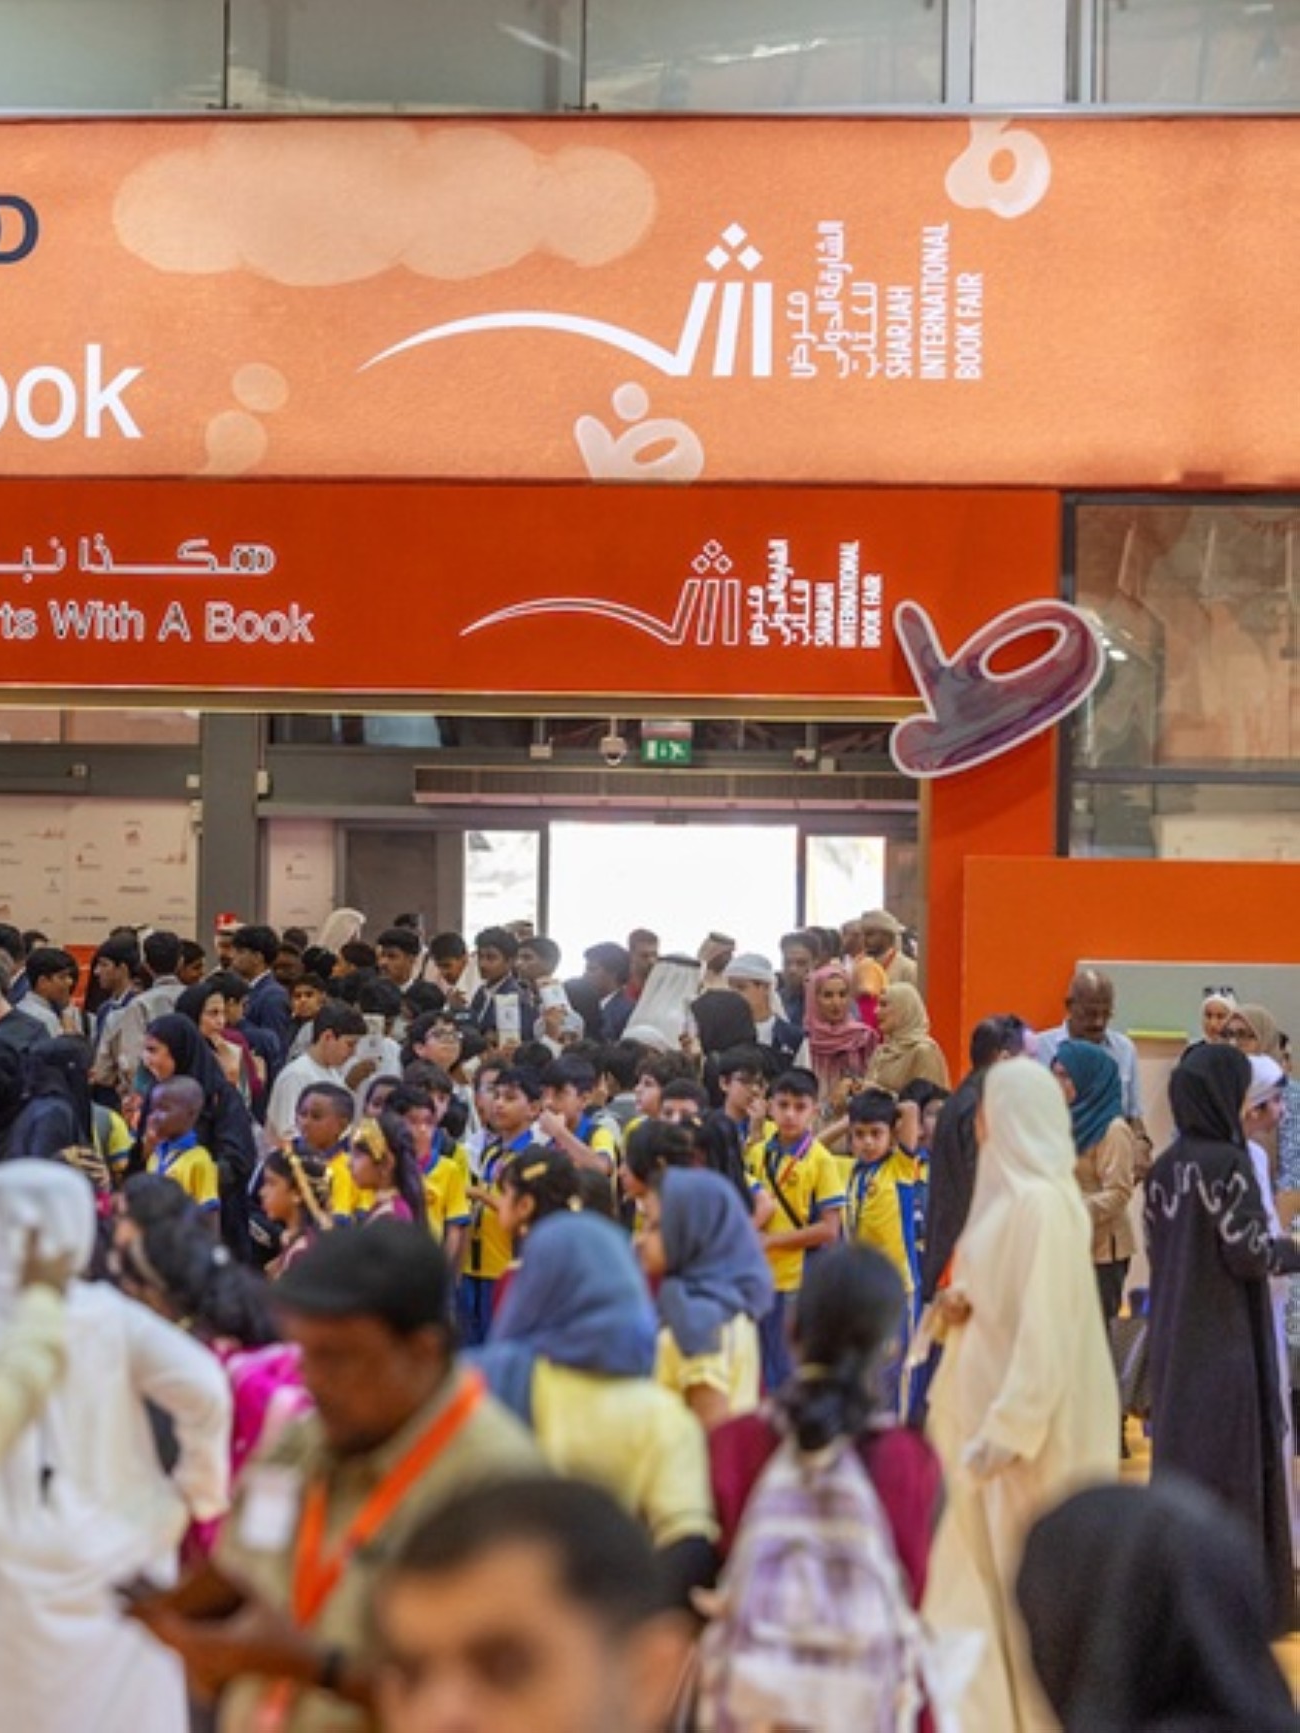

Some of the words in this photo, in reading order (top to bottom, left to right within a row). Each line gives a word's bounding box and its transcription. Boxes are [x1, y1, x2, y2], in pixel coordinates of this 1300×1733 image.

[919, 221, 950, 380] INTERNATIONAL
[954, 272, 984, 319] FAIR
[885, 285, 914, 379] SHARJAH
[953, 322, 983, 380] BOOK
[78, 532, 277, 576] هكذا
[47, 599, 145, 642] With
[157, 600, 192, 642] A
[204, 601, 316, 643] Book
